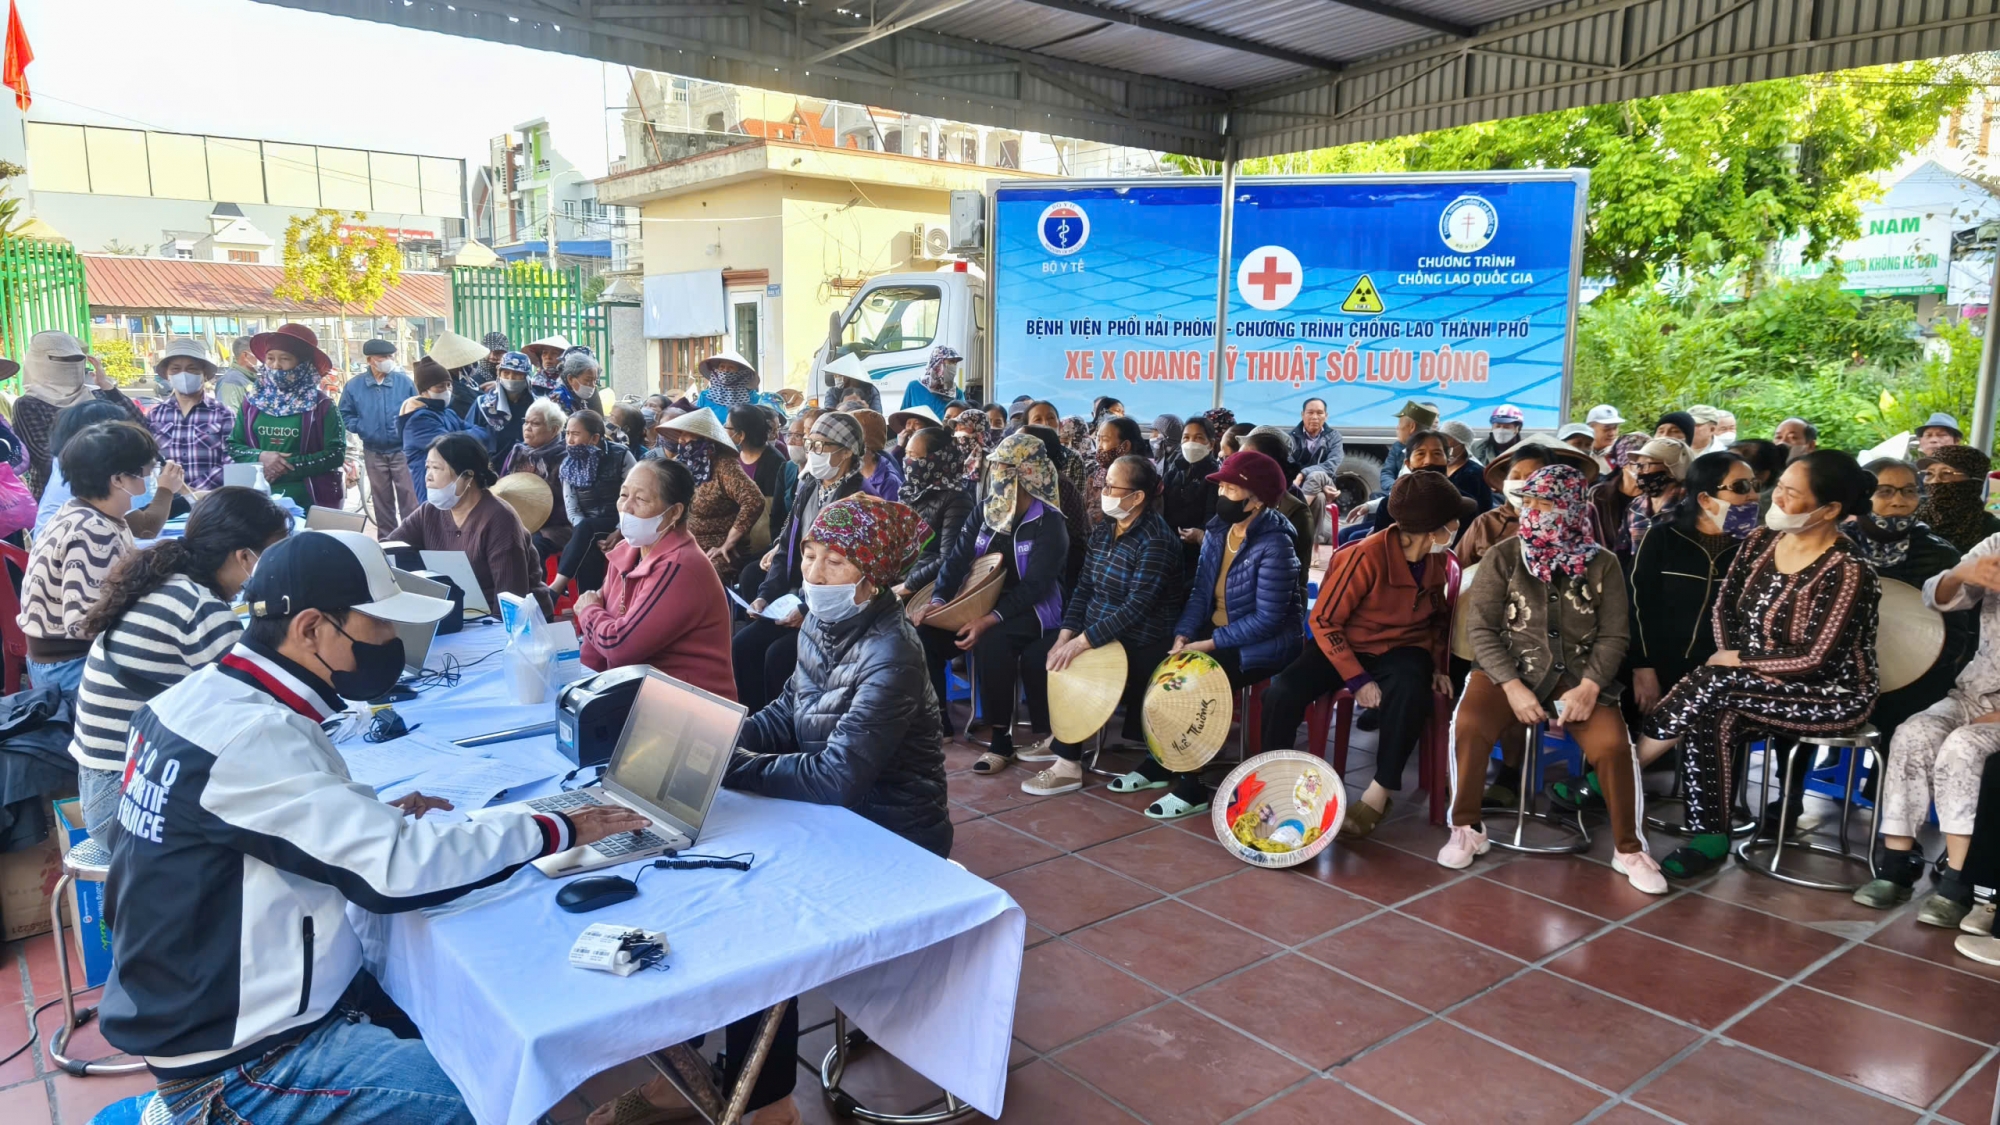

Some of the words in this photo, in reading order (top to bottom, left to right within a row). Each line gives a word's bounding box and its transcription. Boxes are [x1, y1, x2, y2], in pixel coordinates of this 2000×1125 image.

[1870, 217, 1921, 236] NAM
[1042, 260, 1057, 274] BỘ
[1060, 262, 1068, 272] Y
[1070, 257, 1085, 272] TẾ
[1418, 255, 1471, 268] CHƯƠNG
[1474, 253, 1515, 268] TRÌNH
[1868, 254, 1900, 271] KHÔNG
[1398, 269, 1442, 285] CHỐNG
[1445, 273, 1470, 284] LAO
[1473, 268, 1508, 286] QUỐC
[1511, 273, 1533, 284] GIA
[1026, 317, 1063, 339] BỆNH
[1070, 317, 1101, 340] VIỆN
[1107, 313, 1141, 336] PHỔI
[1145, 313, 1168, 336] HẢI
[1236, 318, 1295, 337] CHƯƠNG
[1301, 318, 1344, 338] TRÌNH
[1349, 315, 1400, 338] CHỐNG
[1405, 321, 1434, 338] LAO
[1441, 318, 1491, 338] THÀNH
[1498, 314, 1532, 338] PHỐ
[1064, 350, 1094, 380] XE
[1100, 350, 1116, 380] X
[1123, 350, 1201, 383] QUANG
[1245, 345, 1320, 388] THUẬT
[1326, 341, 1361, 382] SỐ
[1366, 348, 1414, 382] LƯU
[1419, 345, 1489, 389] ĐỘNG
[258, 425, 299, 438] GUSIOC
